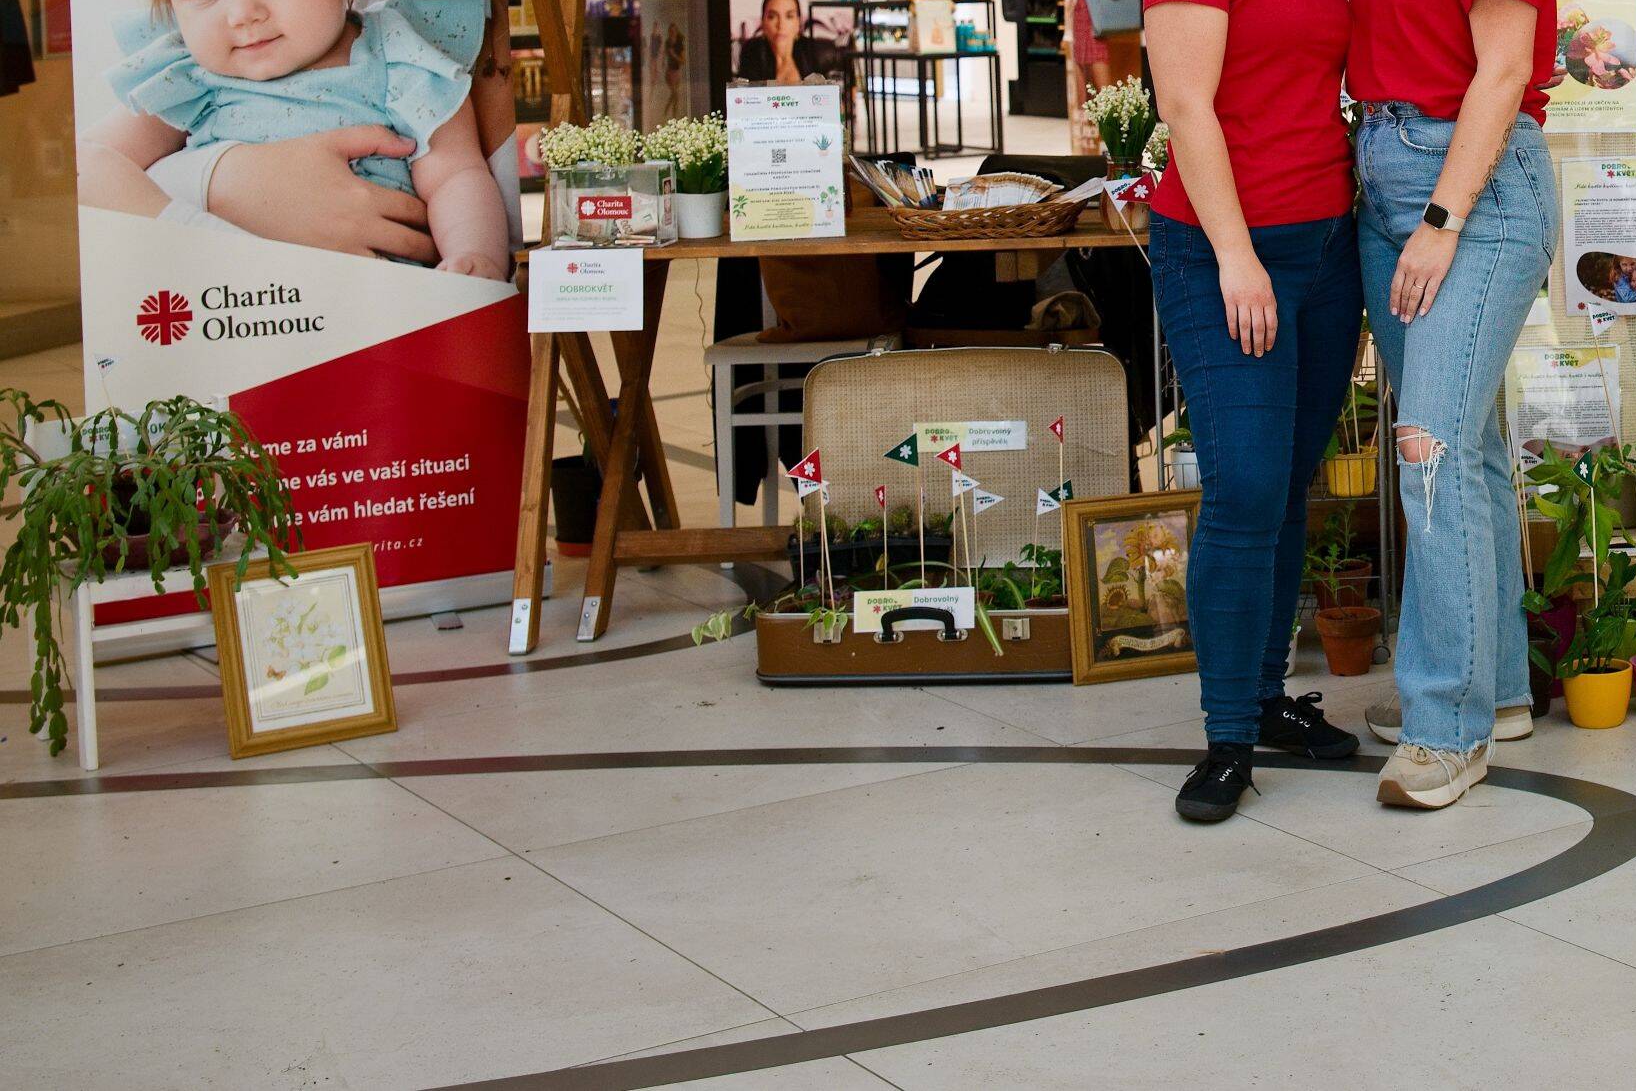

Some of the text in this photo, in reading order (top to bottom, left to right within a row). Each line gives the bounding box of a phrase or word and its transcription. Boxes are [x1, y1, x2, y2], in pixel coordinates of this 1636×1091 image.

[202, 284, 301, 309] Charita
[203, 314, 325, 341] Olomouc
[297, 430, 368, 452] za vámi
[307, 454, 470, 489] vás ve vaší situaci
[309, 488, 475, 524] vám hledat řešení
[914, 595, 958, 606] Dobrovolný
